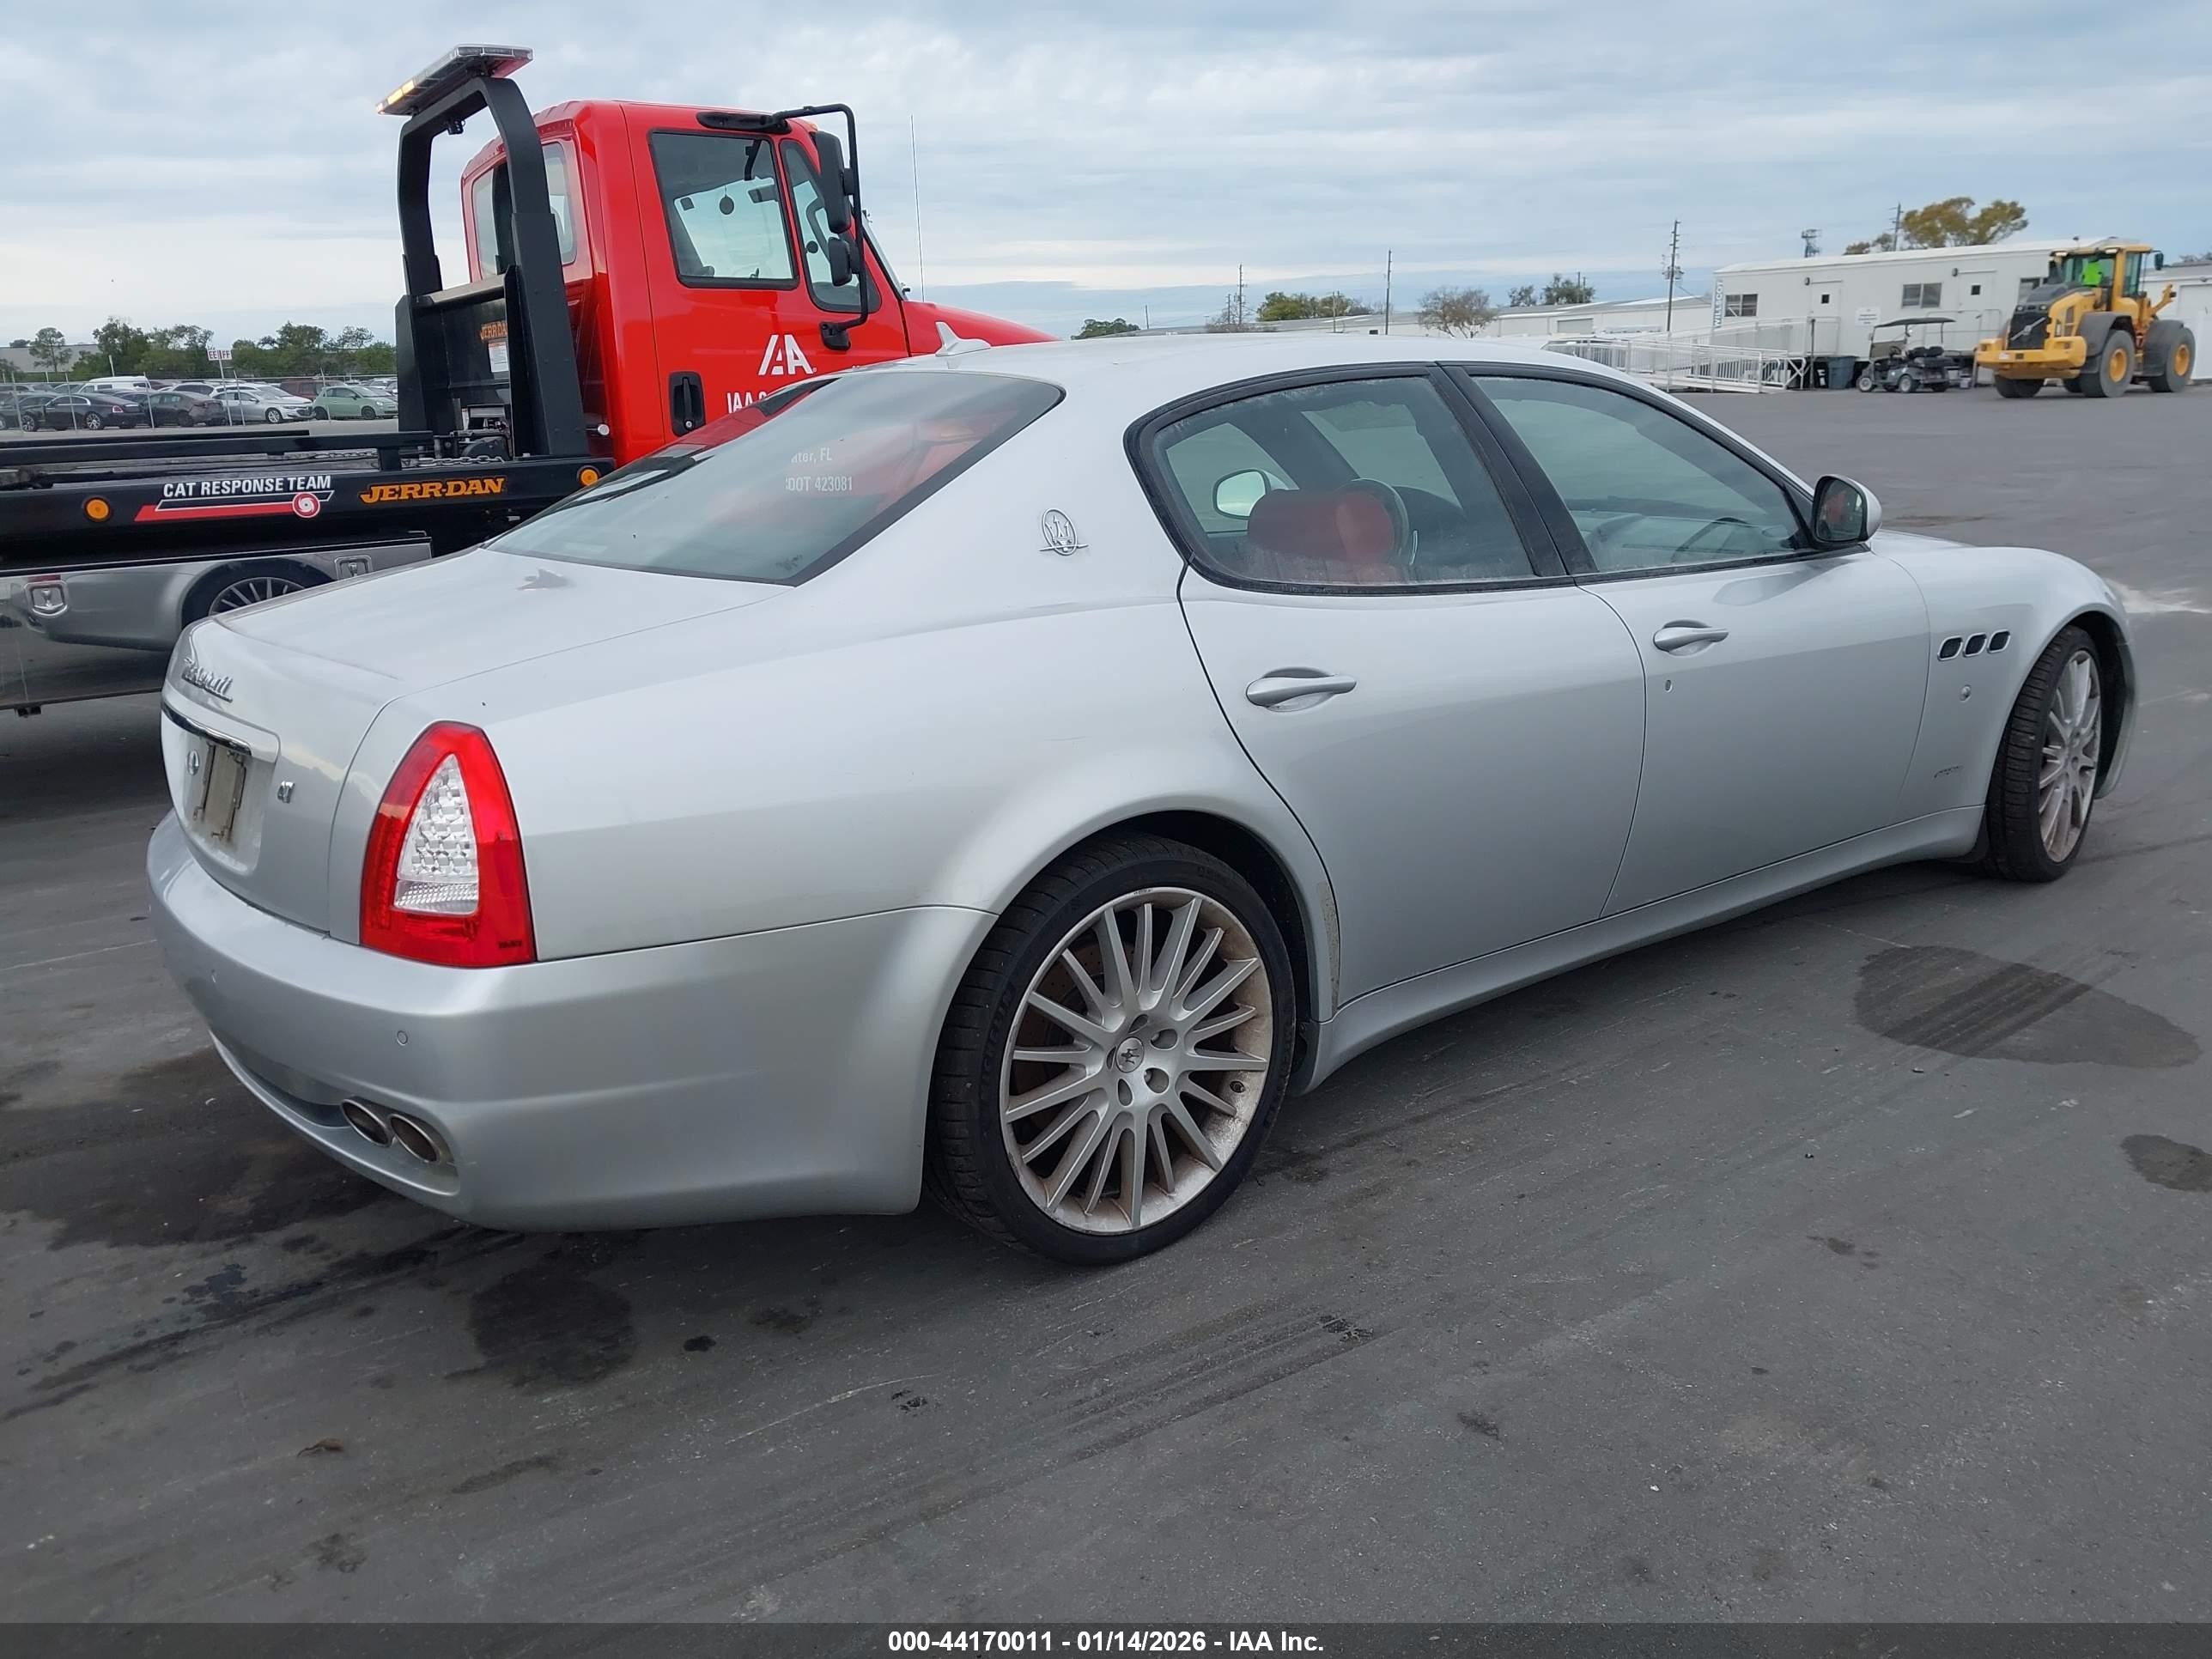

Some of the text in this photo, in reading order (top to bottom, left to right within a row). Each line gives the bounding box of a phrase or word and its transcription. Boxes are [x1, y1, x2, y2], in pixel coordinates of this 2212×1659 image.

[820, 447, 833, 461] FL
[163, 475, 331, 498] CAT RESPONSE TEAM
[361, 478, 505, 503] JERR-DAN
[814, 476, 853, 492] 423081
